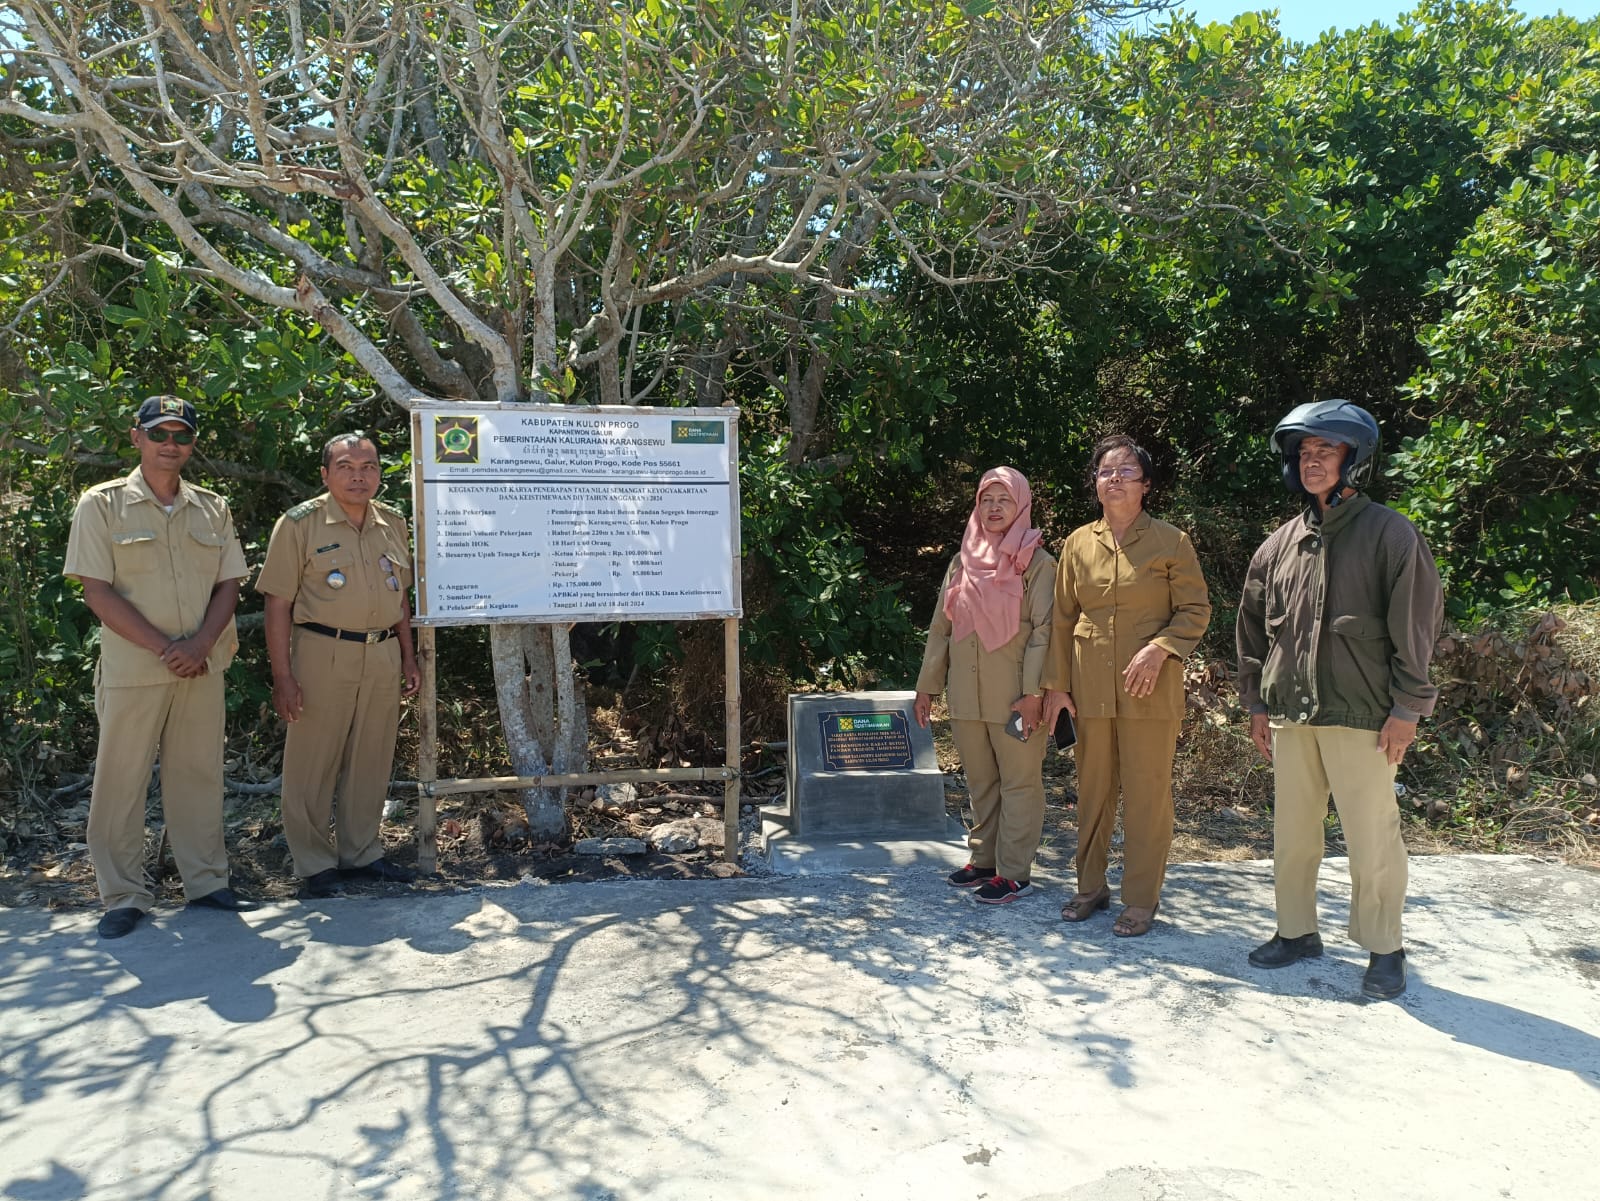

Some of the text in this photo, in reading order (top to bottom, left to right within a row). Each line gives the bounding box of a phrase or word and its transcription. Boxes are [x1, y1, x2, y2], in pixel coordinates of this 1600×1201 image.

[521, 418, 640, 429] KABUPATEN KULON PROGO
[549, 428, 590, 436] KAPANEWON
[493, 435, 666, 447] PEMERINTAHAN KALURAHAN KARANGSEWU
[490, 458, 543, 466] Karangsewu,
